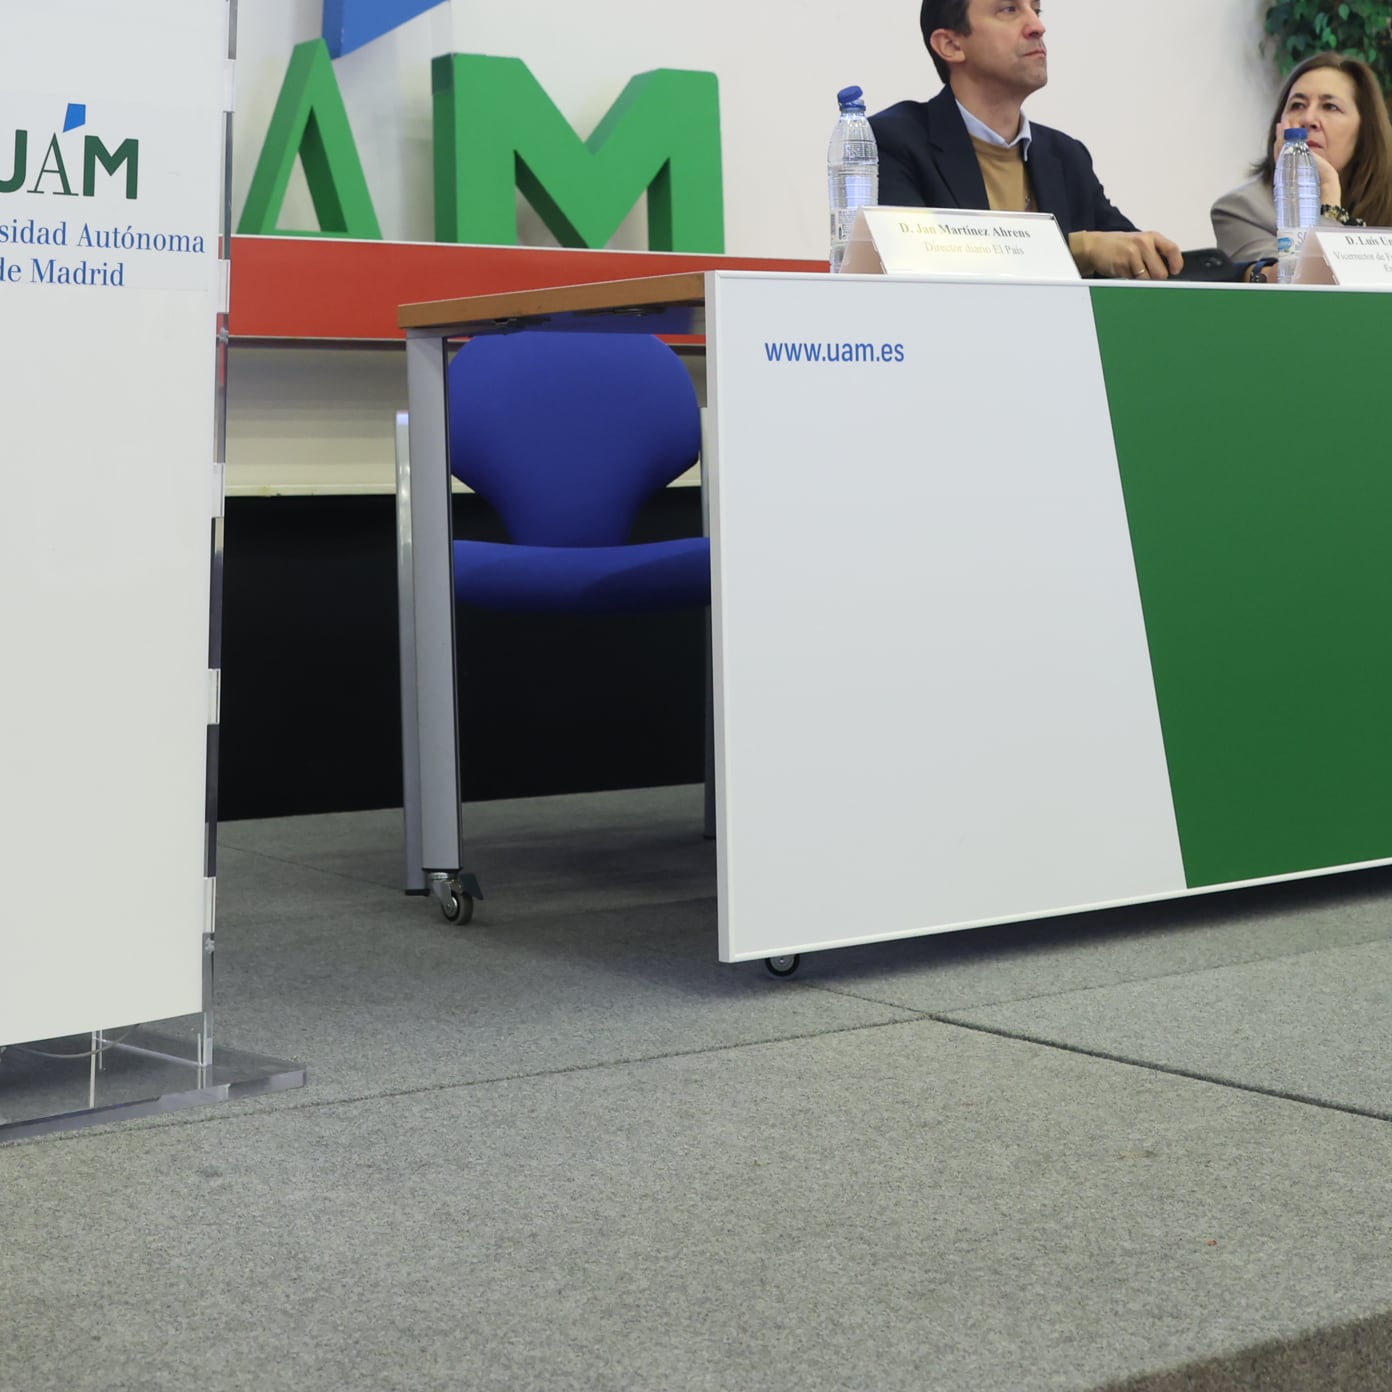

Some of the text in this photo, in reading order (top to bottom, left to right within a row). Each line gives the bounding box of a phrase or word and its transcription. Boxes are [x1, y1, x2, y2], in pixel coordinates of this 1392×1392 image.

[76, 222, 206, 254] Autónoma
[899, 222, 1031, 238] D. Jan Martínez Ahrens
[925, 242, 964, 254] Director
[993, 243, 1004, 255] El
[1345, 235, 1358, 246] D.
[1359, 236, 1380, 246] Luis
[30, 258, 125, 287] Madrid
[763, 339, 905, 363] www.uam.es
